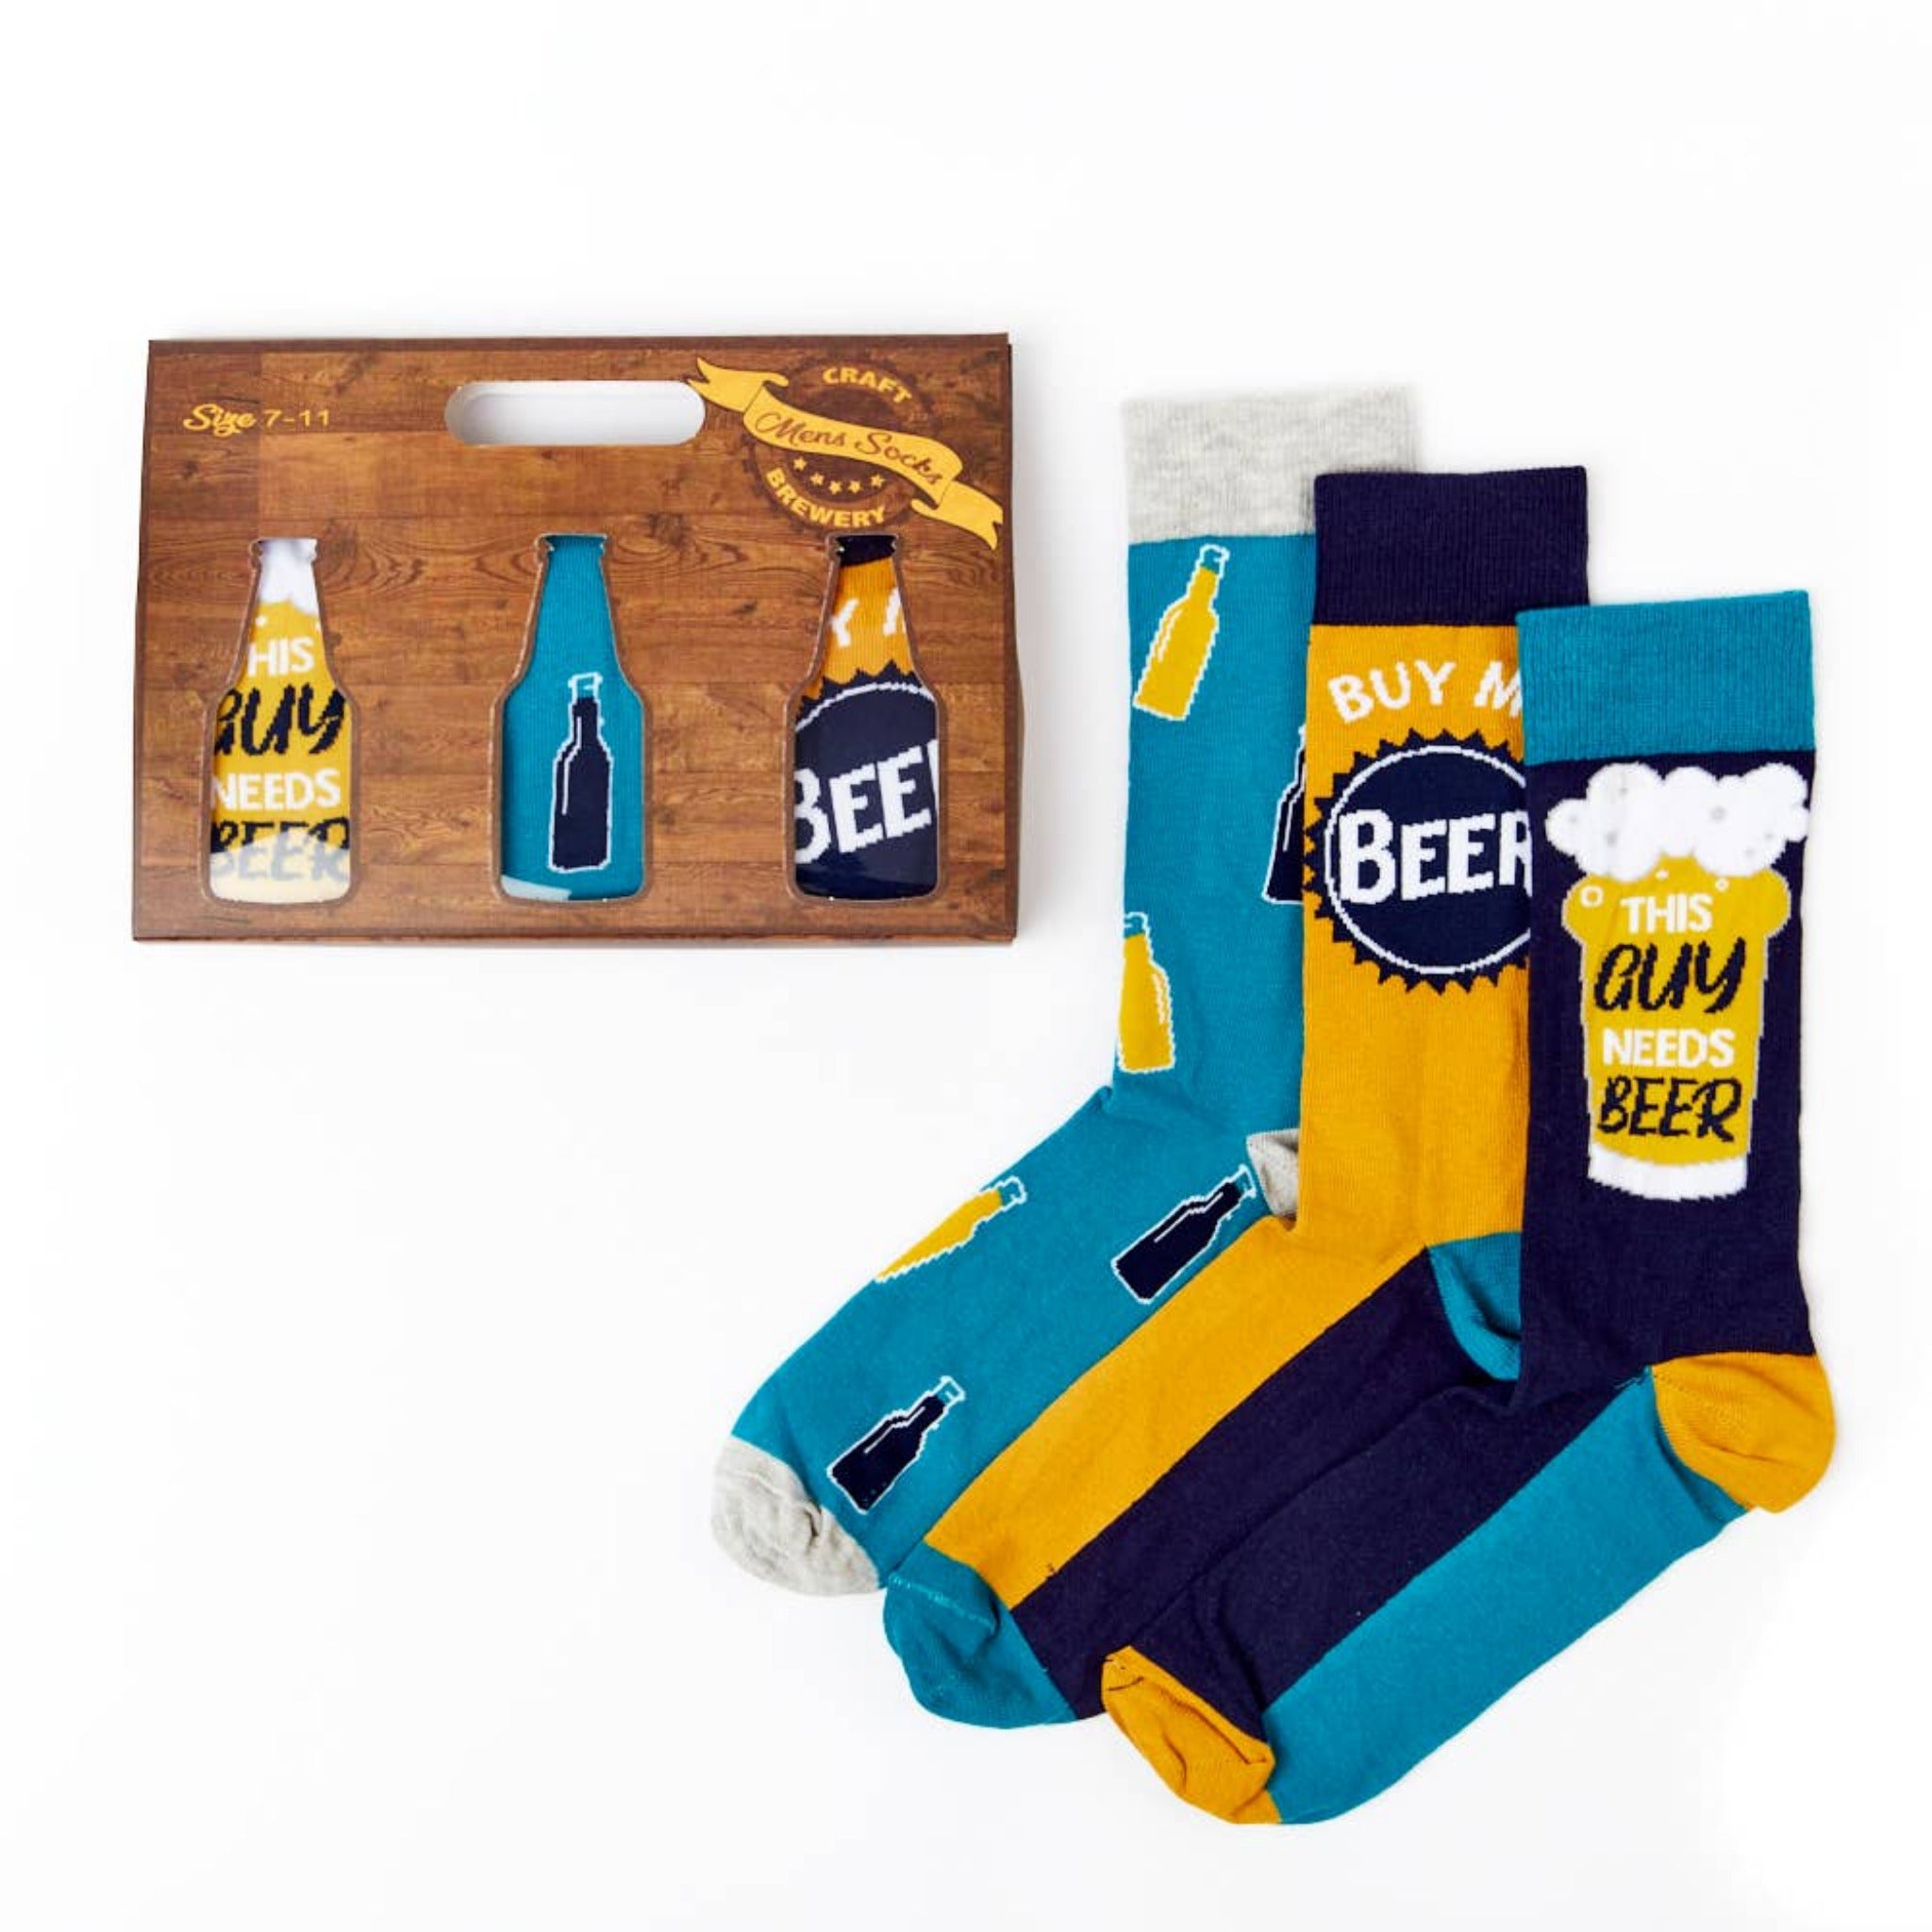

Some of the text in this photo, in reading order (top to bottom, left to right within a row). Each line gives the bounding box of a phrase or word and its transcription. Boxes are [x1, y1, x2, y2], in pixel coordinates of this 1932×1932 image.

[823, 366, 911, 404] CRAFT
[183, 403, 331, 438] Size 7-11
[754, 411, 944, 486] Mens Socks
[765, 467, 888, 528] BREWERY
[246, 636, 314, 677] HIS
[1328, 659, 1523, 724] BUY M
[211, 767, 341, 812] NEEDS
[794, 739, 940, 865] BEE
[1338, 808, 1533, 906] BEER
[1621, 891, 1714, 935] THIS
[1593, 937, 1747, 1013] GUY
[1603, 1027, 1737, 1069] NEEDS
[1597, 1075, 1742, 1142] BEER
